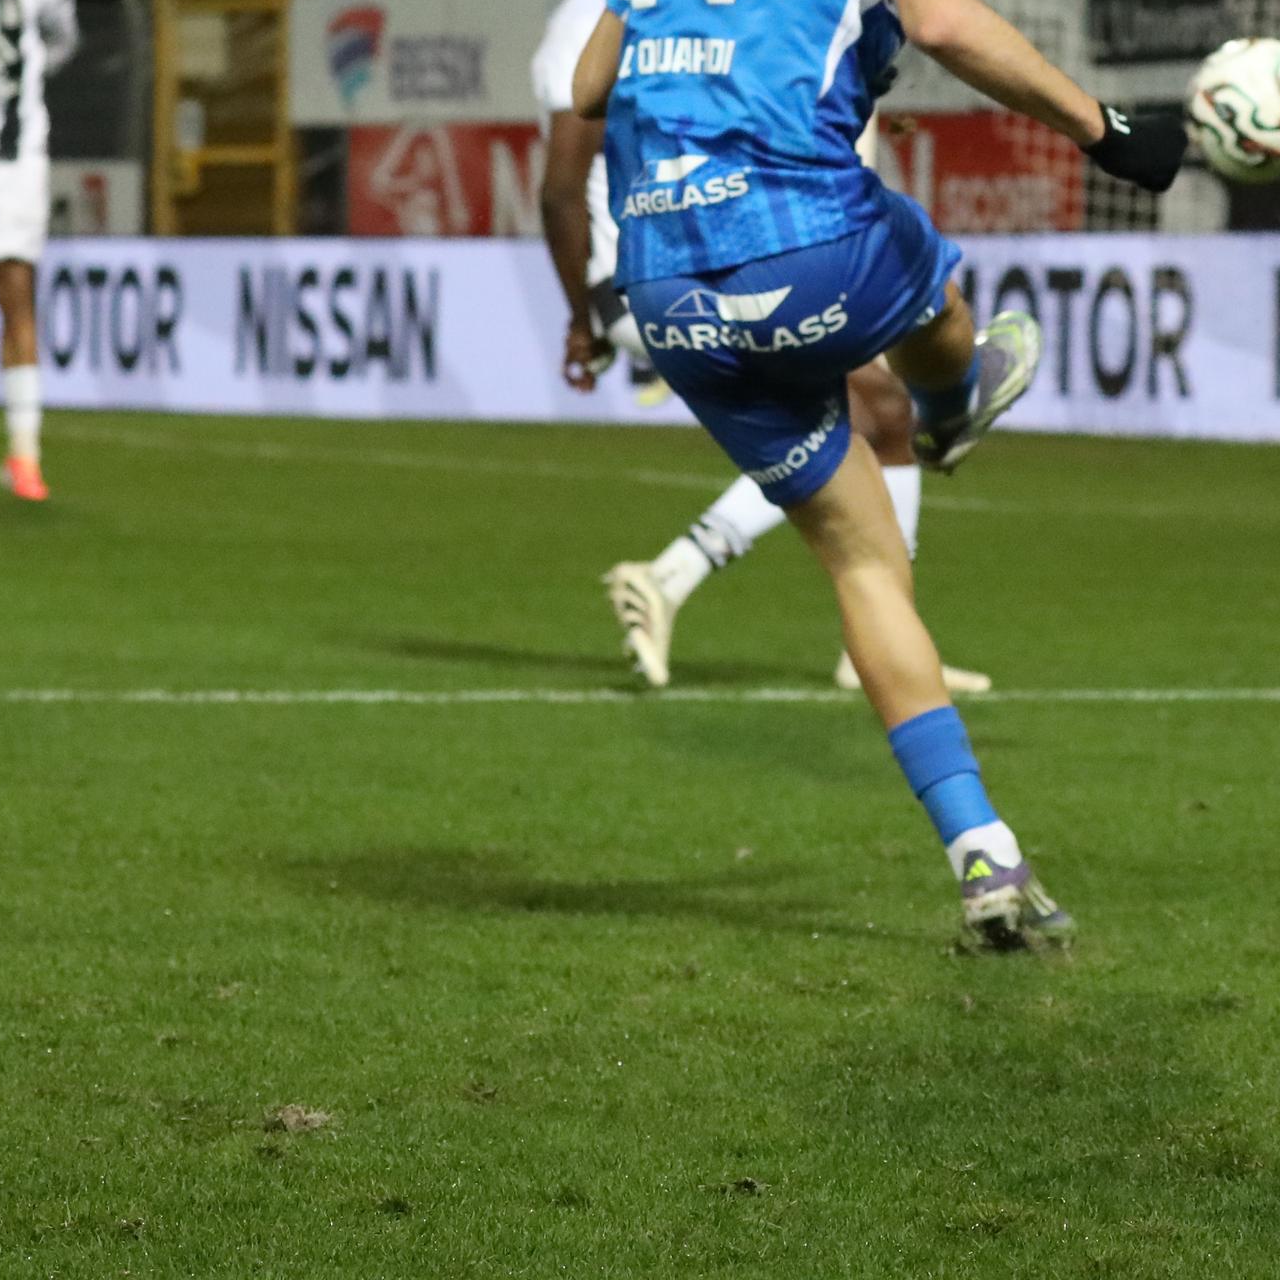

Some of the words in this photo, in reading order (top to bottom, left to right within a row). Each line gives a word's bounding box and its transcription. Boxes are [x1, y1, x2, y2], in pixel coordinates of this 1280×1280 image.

[637, 37, 735, 76] OUAHDI
[621, 171, 750, 221] ARGLASS
[42, 265, 184, 376] OTOR
[233, 265, 441, 381] NISSAN
[962, 265, 1194, 400] TOR
